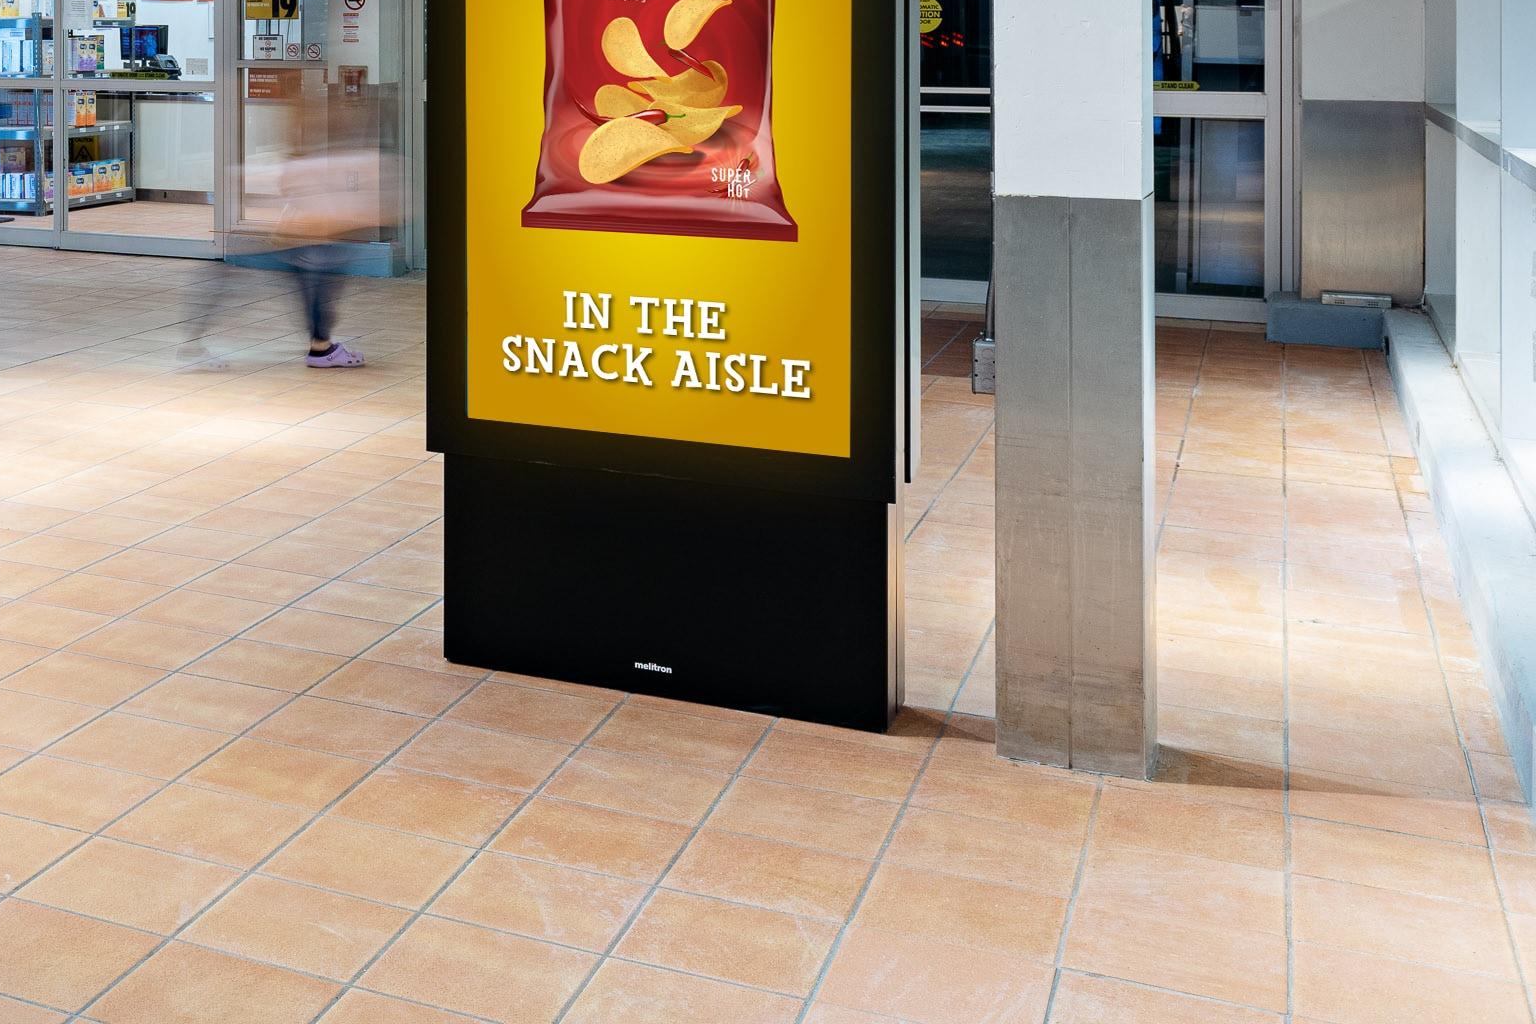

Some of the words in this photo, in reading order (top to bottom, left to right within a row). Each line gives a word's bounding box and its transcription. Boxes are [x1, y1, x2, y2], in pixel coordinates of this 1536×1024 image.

[711, 167, 752, 183] SUPER
[727, 181, 750, 198] HOT
[563, 290, 612, 330] IN
[629, 296, 727, 340] THE
[502, 335, 652, 386] SNACK
[671, 350, 812, 399] AISLE
[634, 662, 672, 674] melitron
